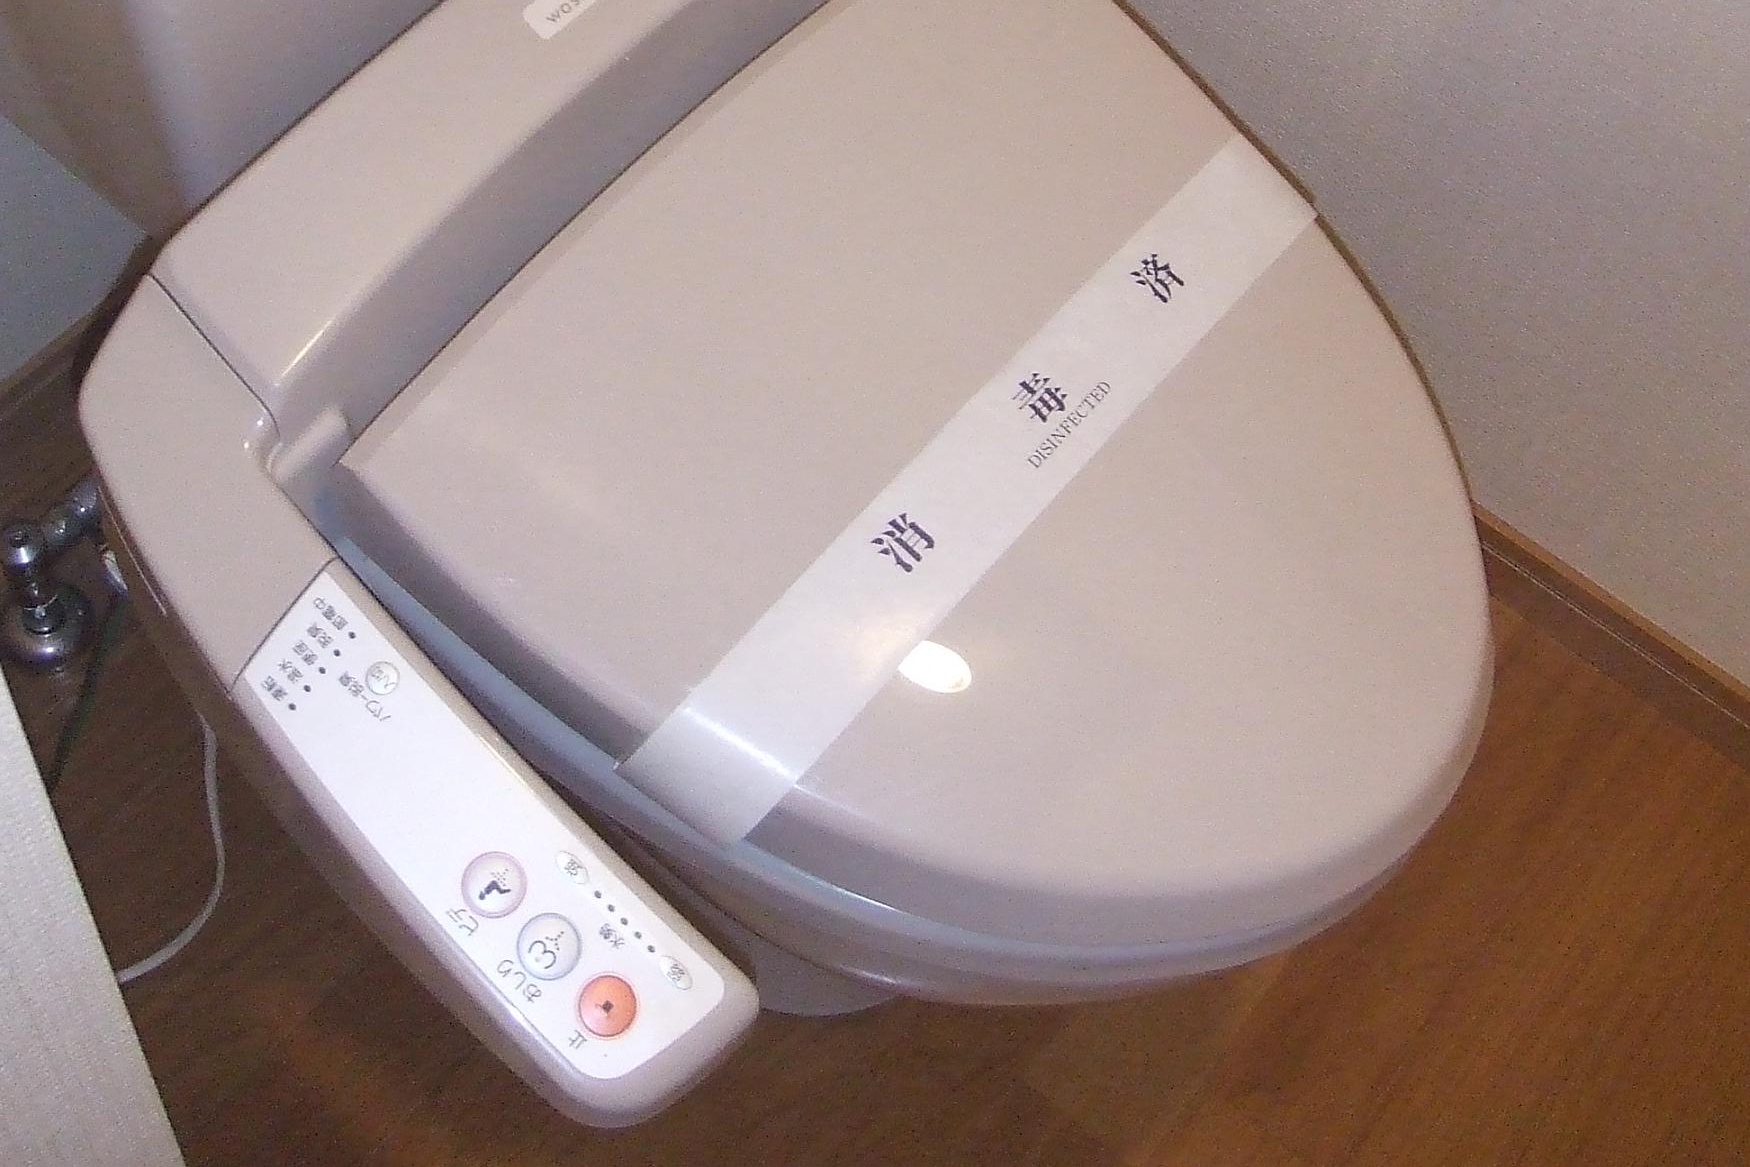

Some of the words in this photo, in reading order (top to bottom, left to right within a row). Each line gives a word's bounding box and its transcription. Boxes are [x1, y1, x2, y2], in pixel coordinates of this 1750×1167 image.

[1026, 379, 1113, 470] DISINFECTED
[277, 658, 304, 684] 温水
[338, 670, 392, 722] パワー脱臭
[496, 958, 543, 1004] おしり
[567, 1029, 588, 1049] 止
